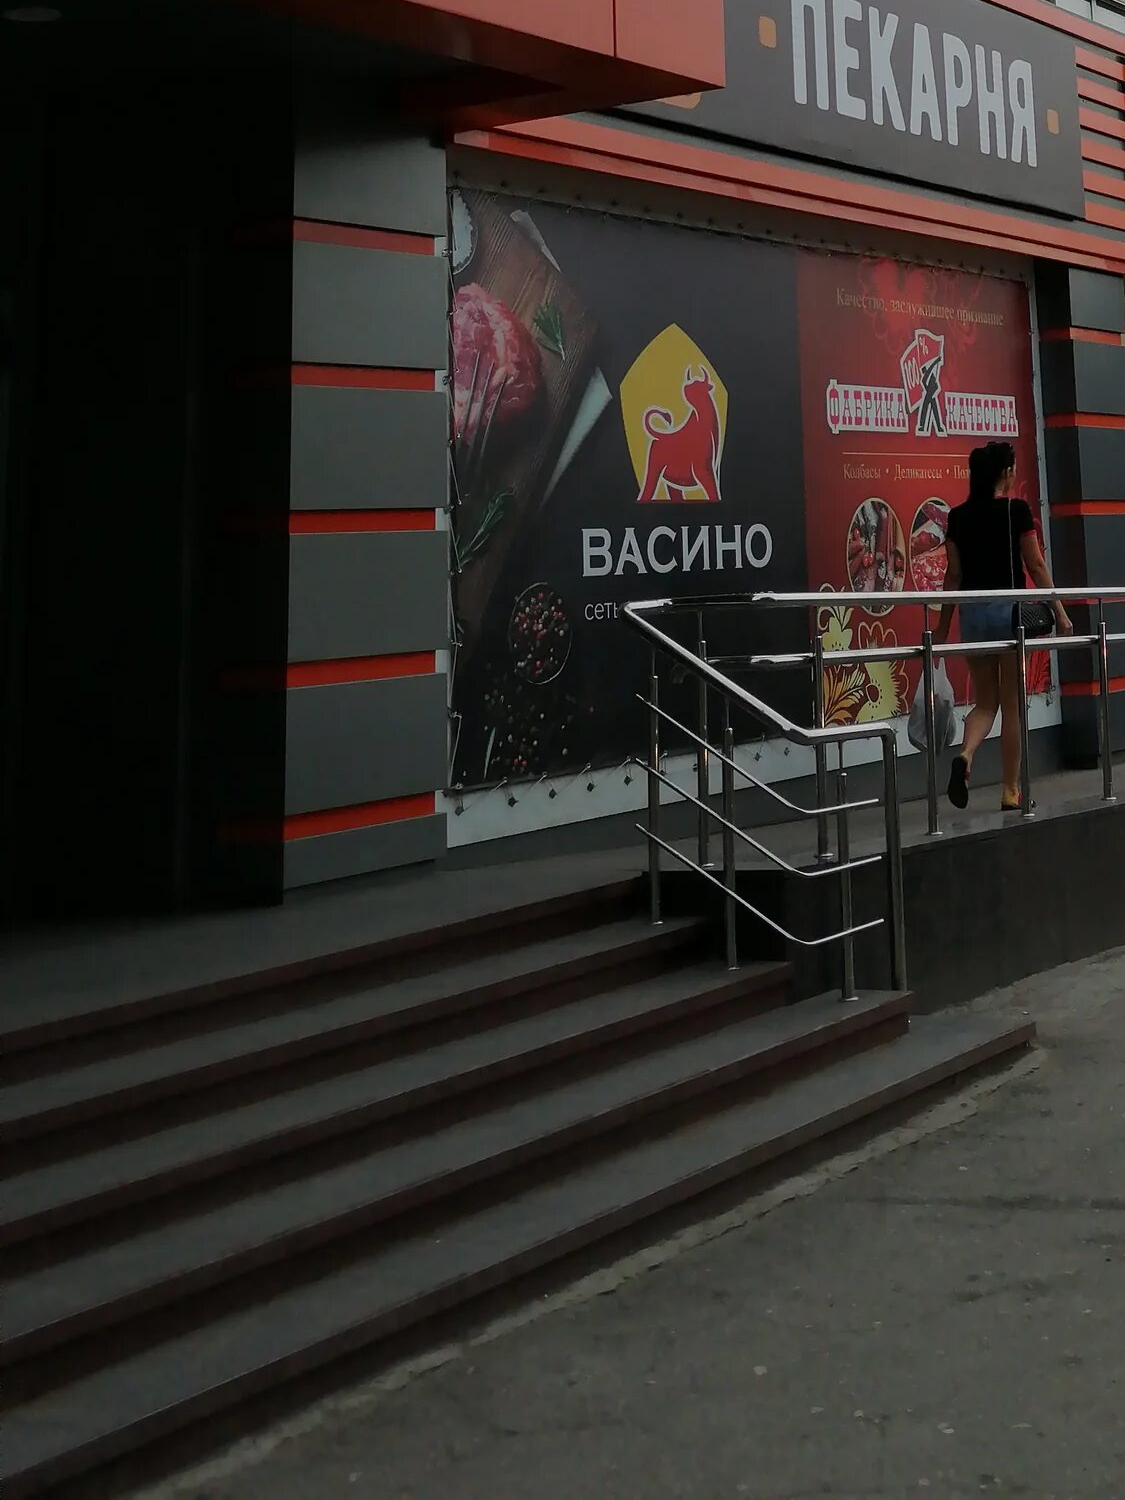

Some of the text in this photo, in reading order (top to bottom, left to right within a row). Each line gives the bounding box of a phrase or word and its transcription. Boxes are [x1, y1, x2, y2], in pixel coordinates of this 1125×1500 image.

[890, 299, 955, 320] заслужившее
[956, 307, 1004, 327] признание
[904, 357, 920, 390] 100
[828, 387, 1018, 433] ФАБРИКА КАЧЕСТВА
[843, 463, 882, 480] Колбасы
[893, 464, 943, 481] Деликатесы
[581, 523, 773, 577] ВАСИНО
